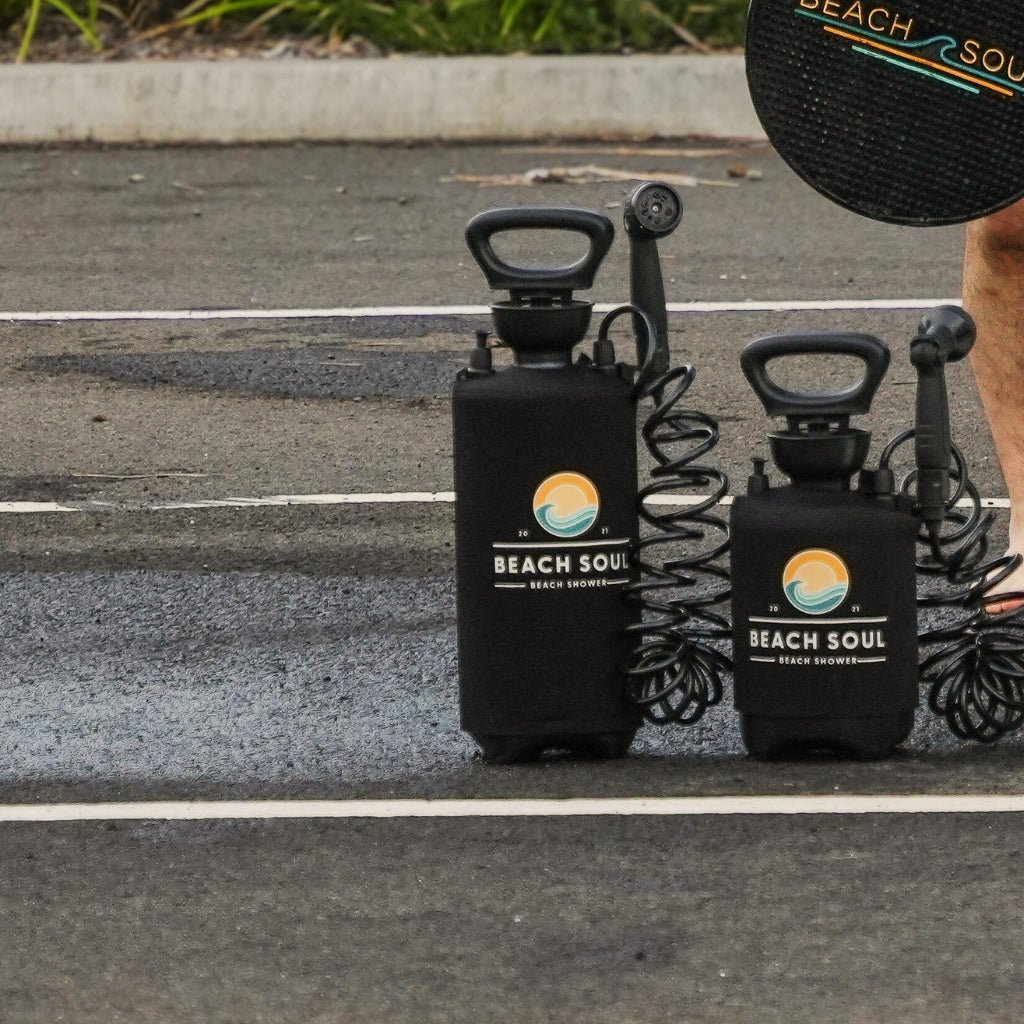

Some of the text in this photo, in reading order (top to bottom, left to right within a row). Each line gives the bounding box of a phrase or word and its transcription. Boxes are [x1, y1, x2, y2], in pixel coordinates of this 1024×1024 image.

[518, 529, 529, 538] 20
[494, 553, 629, 574] BEACH SOUL
[530, 580, 607, 589] BEACH SHOWER
[750, 630, 885, 650] BEACH SOUL
[779, 657, 857, 665] BEACH SHOWER
